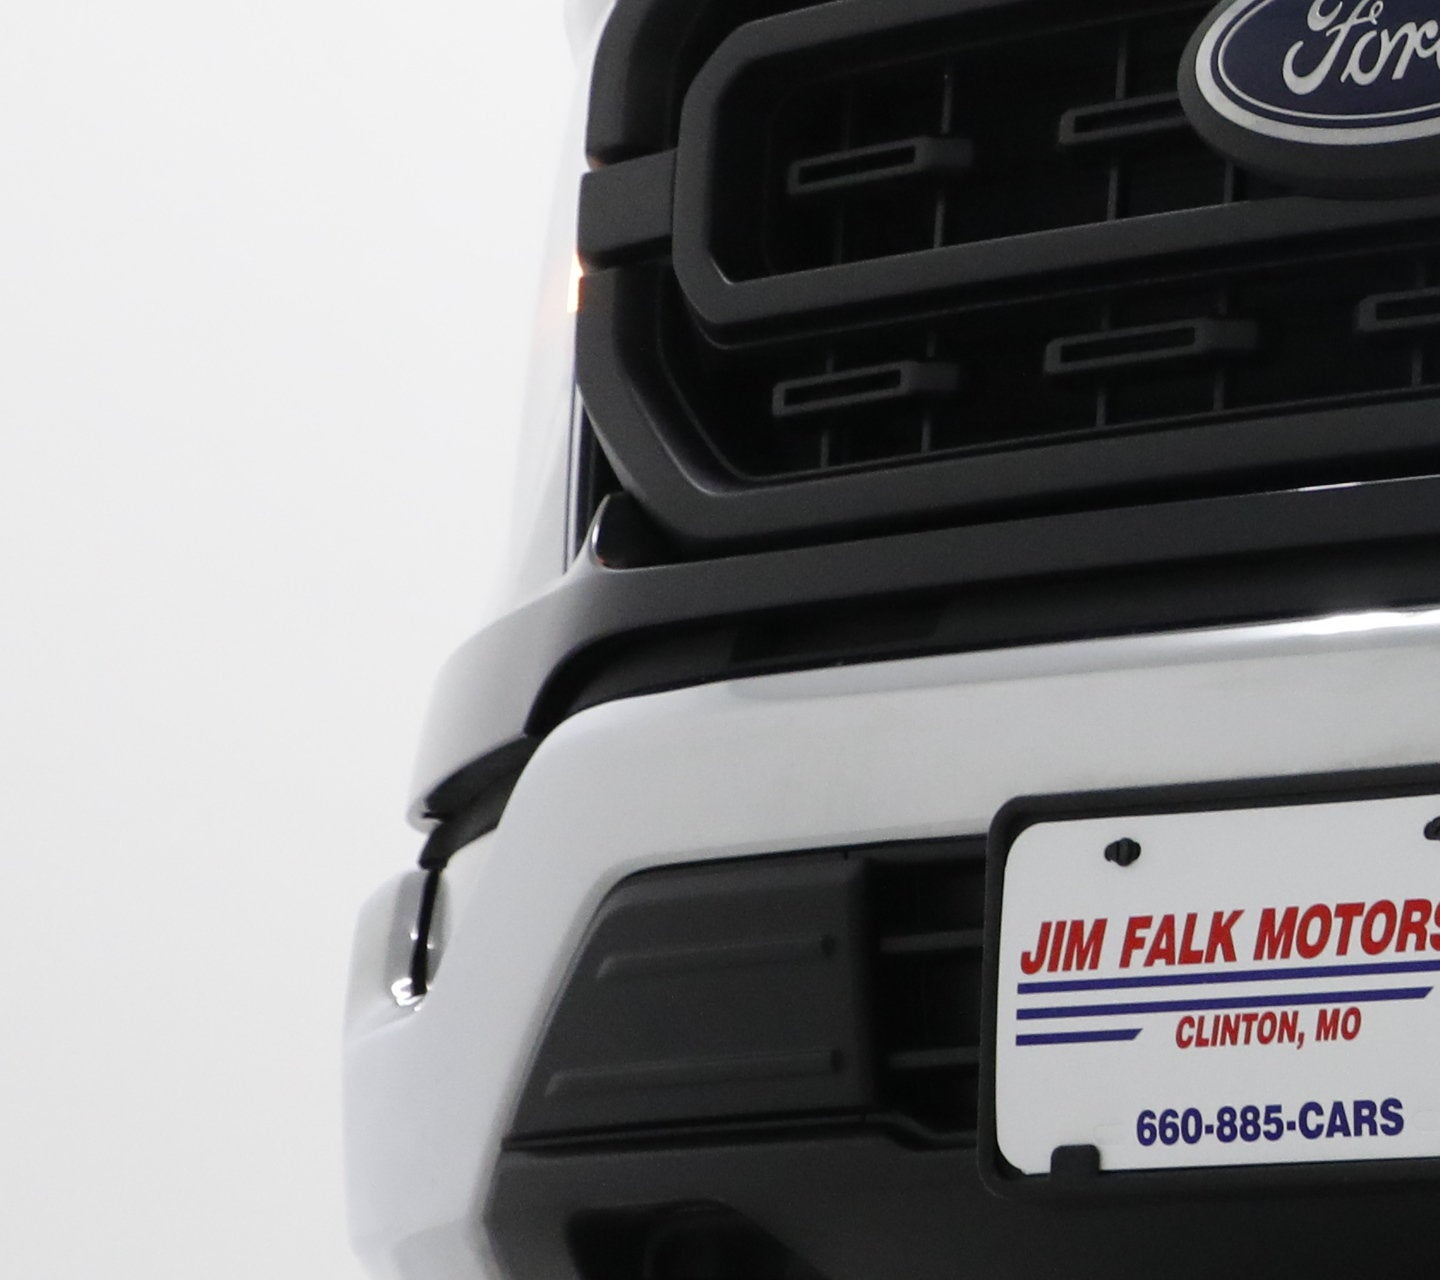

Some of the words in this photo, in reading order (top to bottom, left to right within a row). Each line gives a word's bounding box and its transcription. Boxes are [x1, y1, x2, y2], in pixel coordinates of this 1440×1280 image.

[1020, 917, 1108, 976] JIM
[1119, 909, 1245, 970] FALK
[1175, 1011, 1306, 1051] CLINTON,
[1315, 1006, 1362, 1042] MO
[1136, 1097, 1405, 1147] 660-885-CARS
